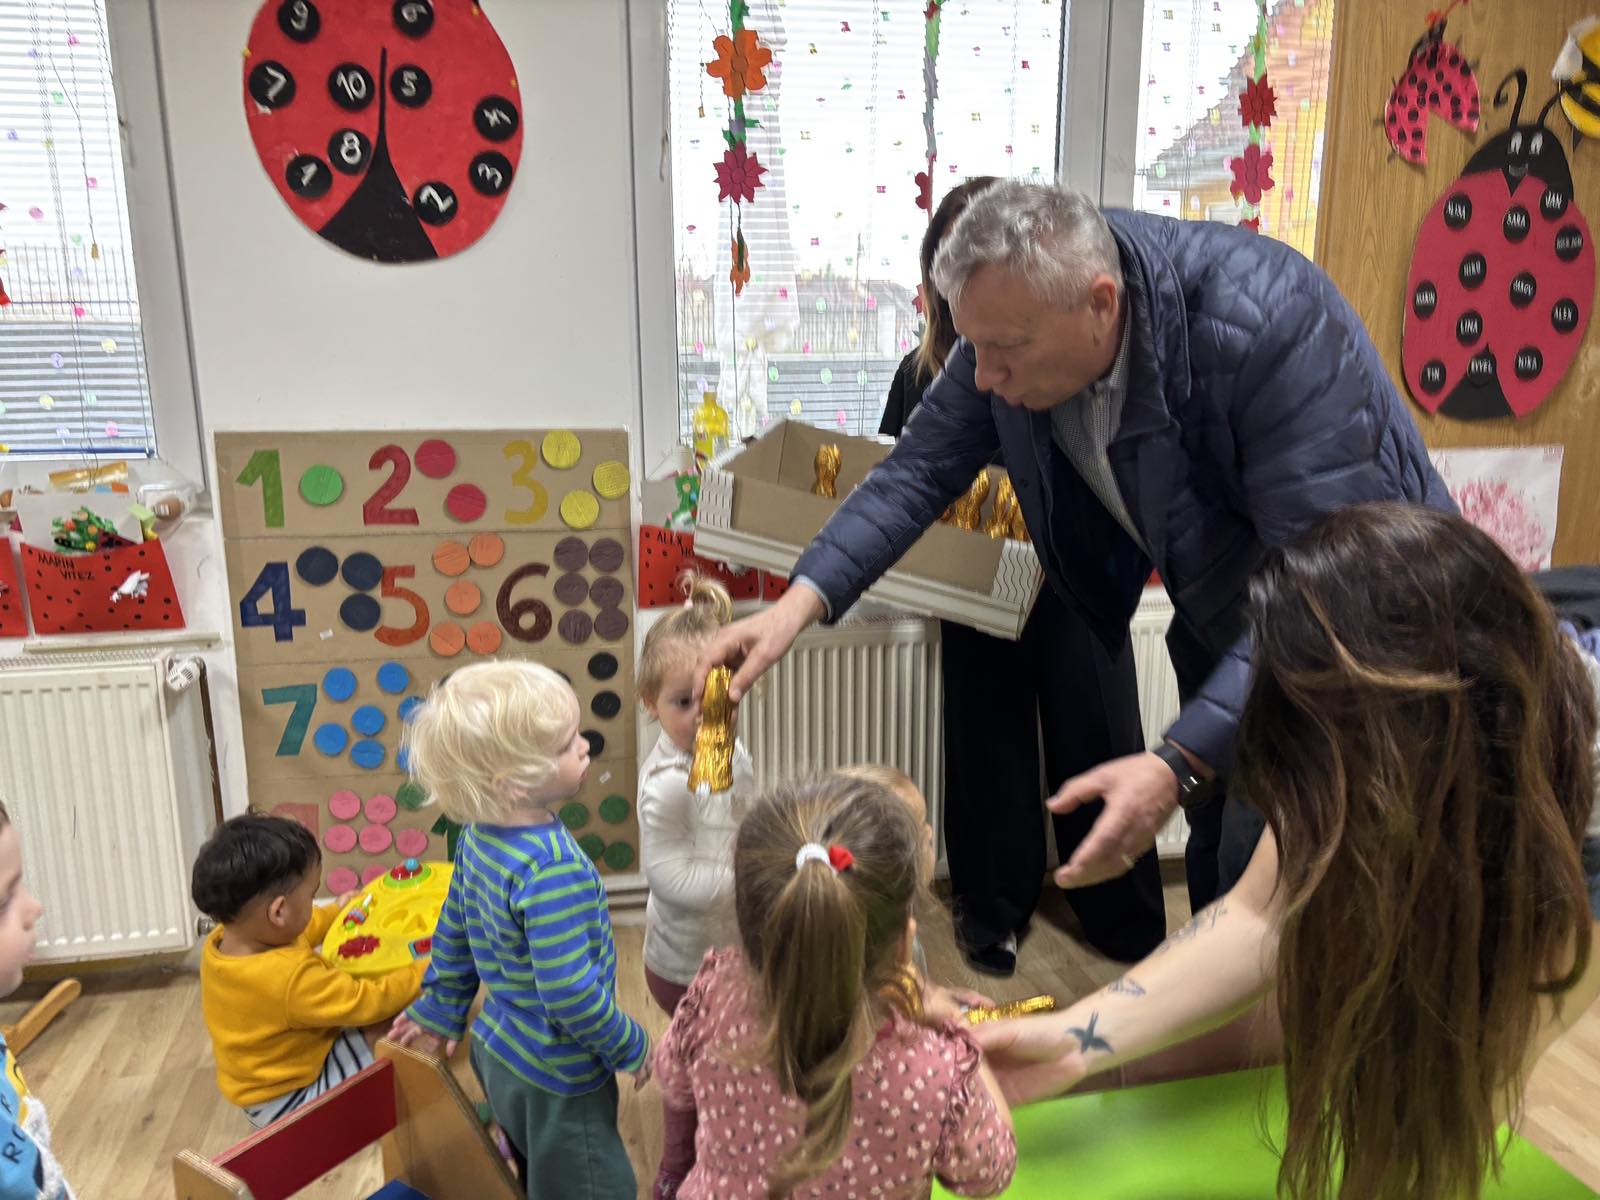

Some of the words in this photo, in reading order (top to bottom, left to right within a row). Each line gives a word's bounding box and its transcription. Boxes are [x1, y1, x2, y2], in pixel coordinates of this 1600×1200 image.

[290, 1, 309, 31] 9
[265, 66, 287, 102] 7
[336, 70, 367, 102] 10
[400, 70, 418, 96] 5
[340, 132, 362, 164] 8
[477, 162, 502, 189] 3
[419, 185, 453, 213] 2
[236, 449, 285, 528] 1
[362, 444, 419, 526] 2
[503, 439, 549, 524] 3
[37, 552, 76, 569] MARIN
[240, 561, 306, 642] 4
[374, 564, 430, 647] 5
[496, 562, 553, 643] 6
[261, 683, 318, 756] 7
